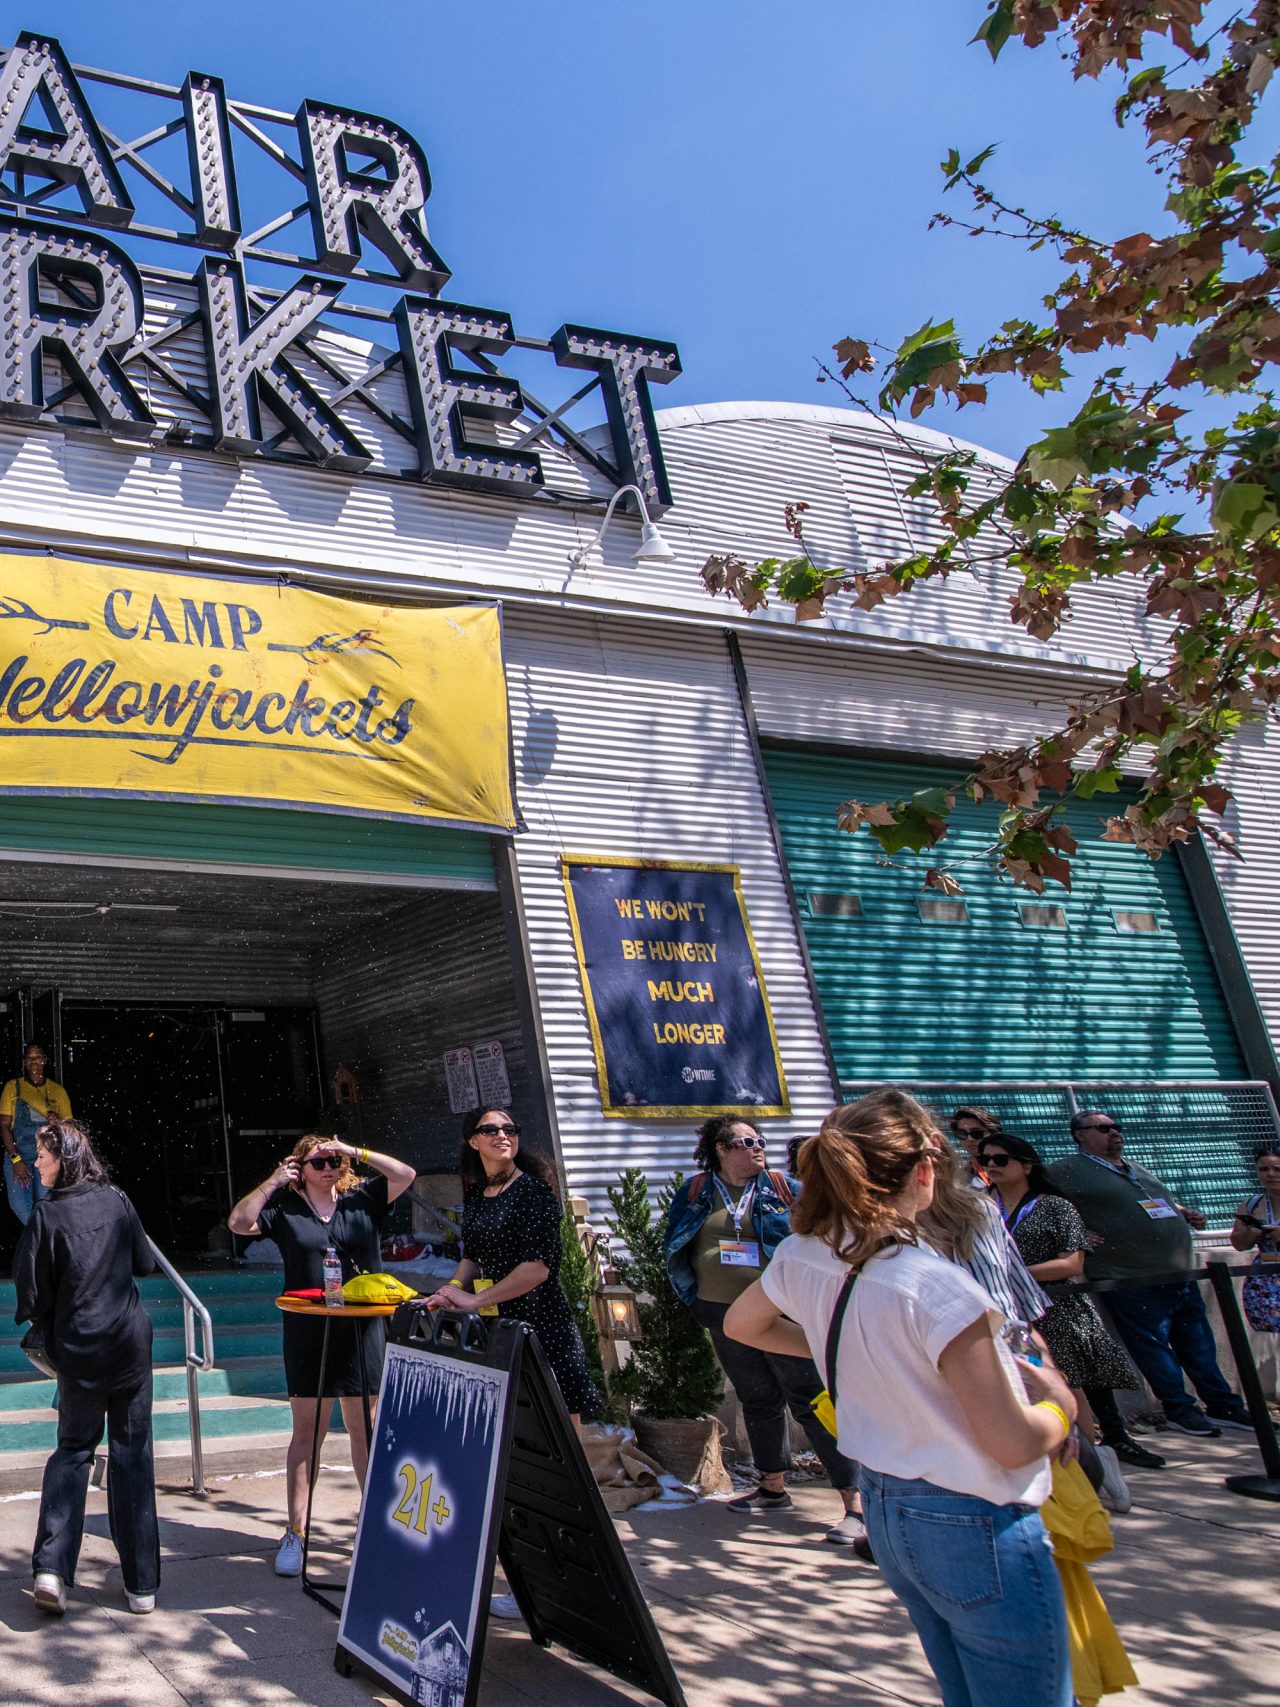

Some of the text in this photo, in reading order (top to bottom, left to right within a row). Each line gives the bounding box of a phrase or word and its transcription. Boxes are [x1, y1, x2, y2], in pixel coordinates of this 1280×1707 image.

[103, 588, 262, 651] CAMP
[615, 898, 706, 922] WE WON'T
[621, 939, 718, 963] BE HUNGRY
[647, 980, 715, 1003] MUCH
[653, 1022, 727, 1045] LONGER
[681, 1066, 717, 1084] SHOWTIME
[392, 1463, 450, 1535] 21+
